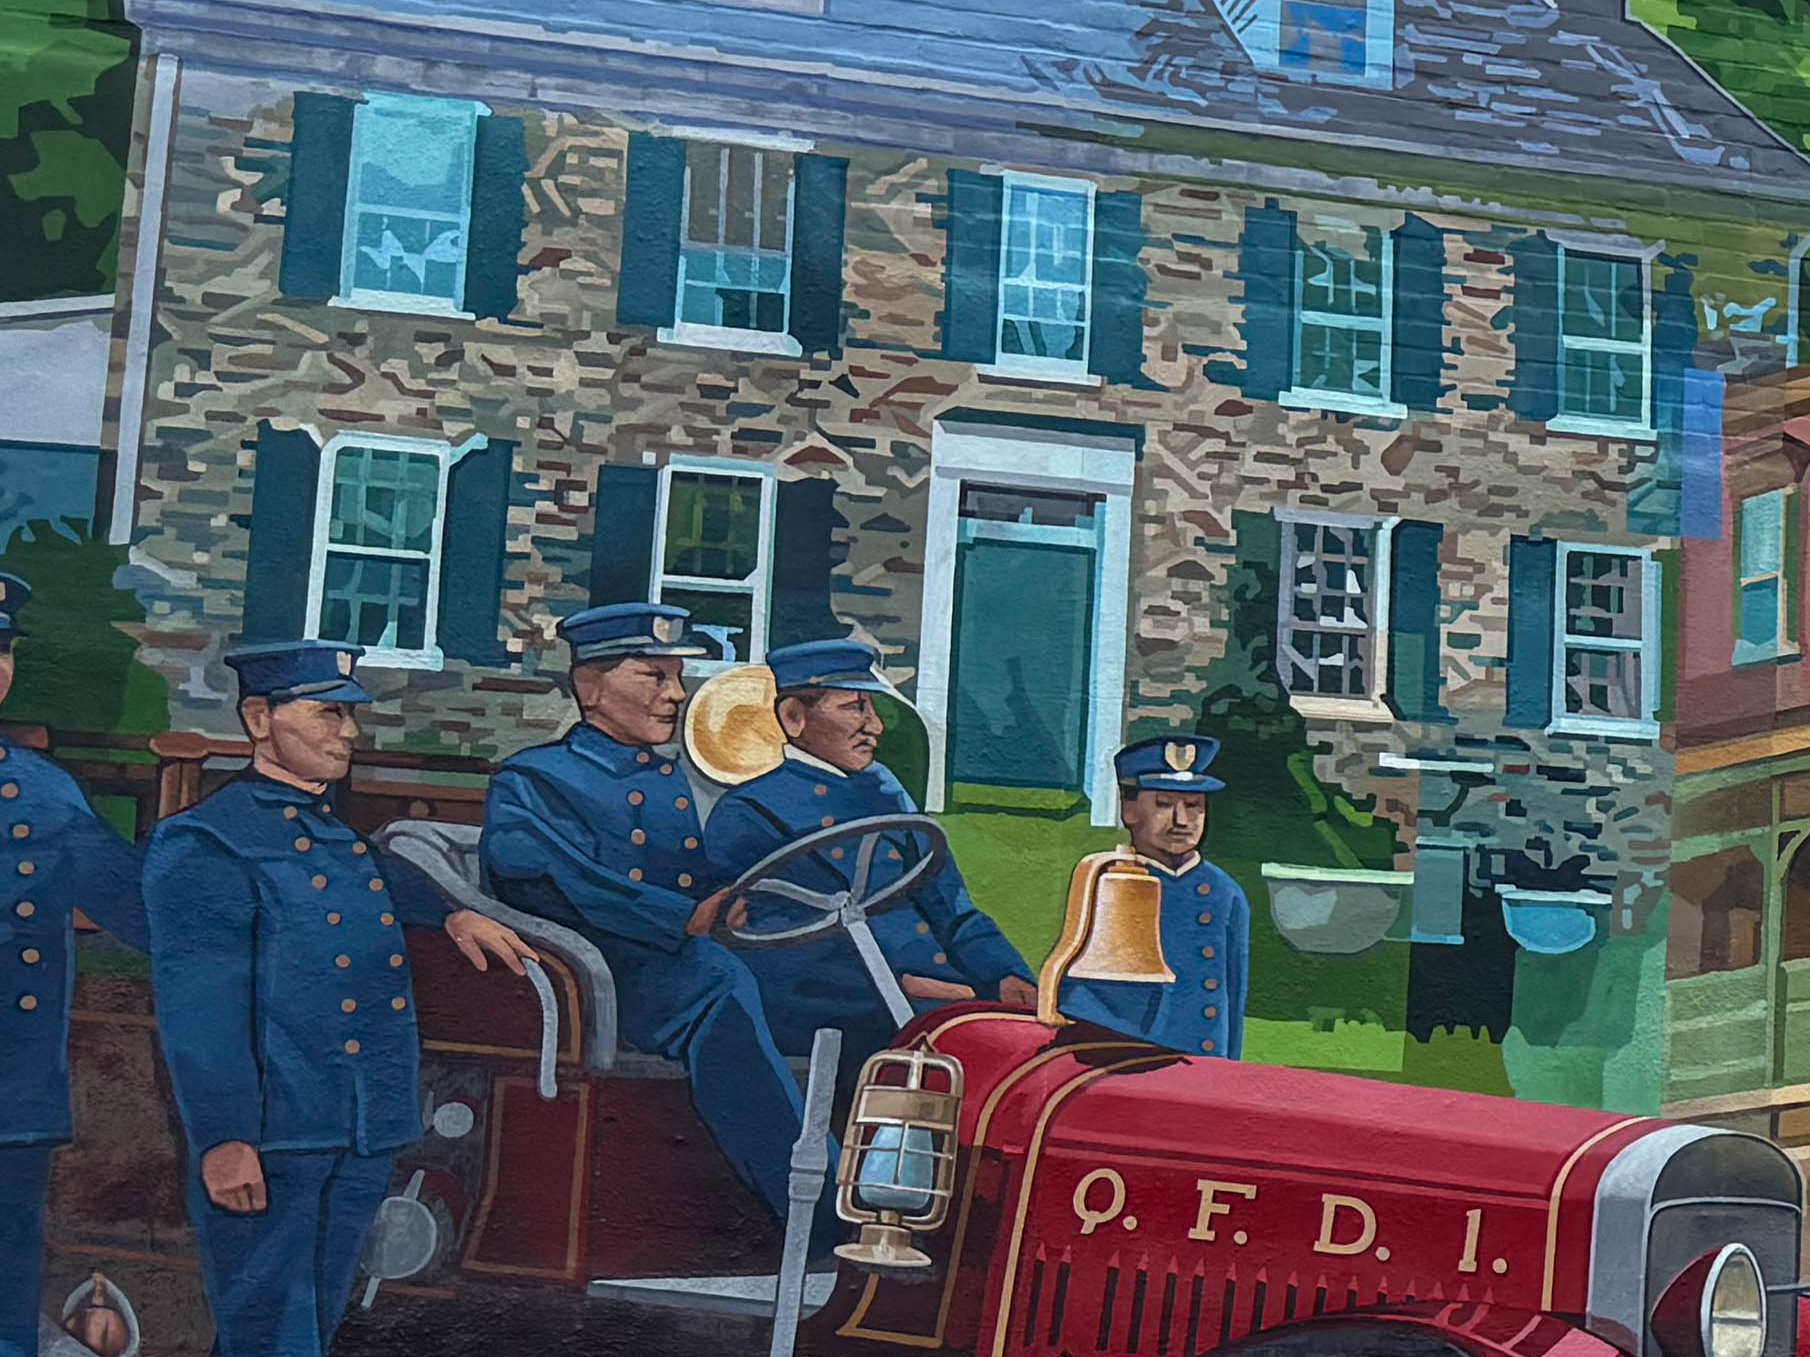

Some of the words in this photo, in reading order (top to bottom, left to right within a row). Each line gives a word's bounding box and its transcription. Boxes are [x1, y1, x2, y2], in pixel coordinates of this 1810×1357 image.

[1072, 1168, 1139, 1235] Q.
[1188, 1178, 1257, 1246] F.
[1313, 1193, 1392, 1262] D.
